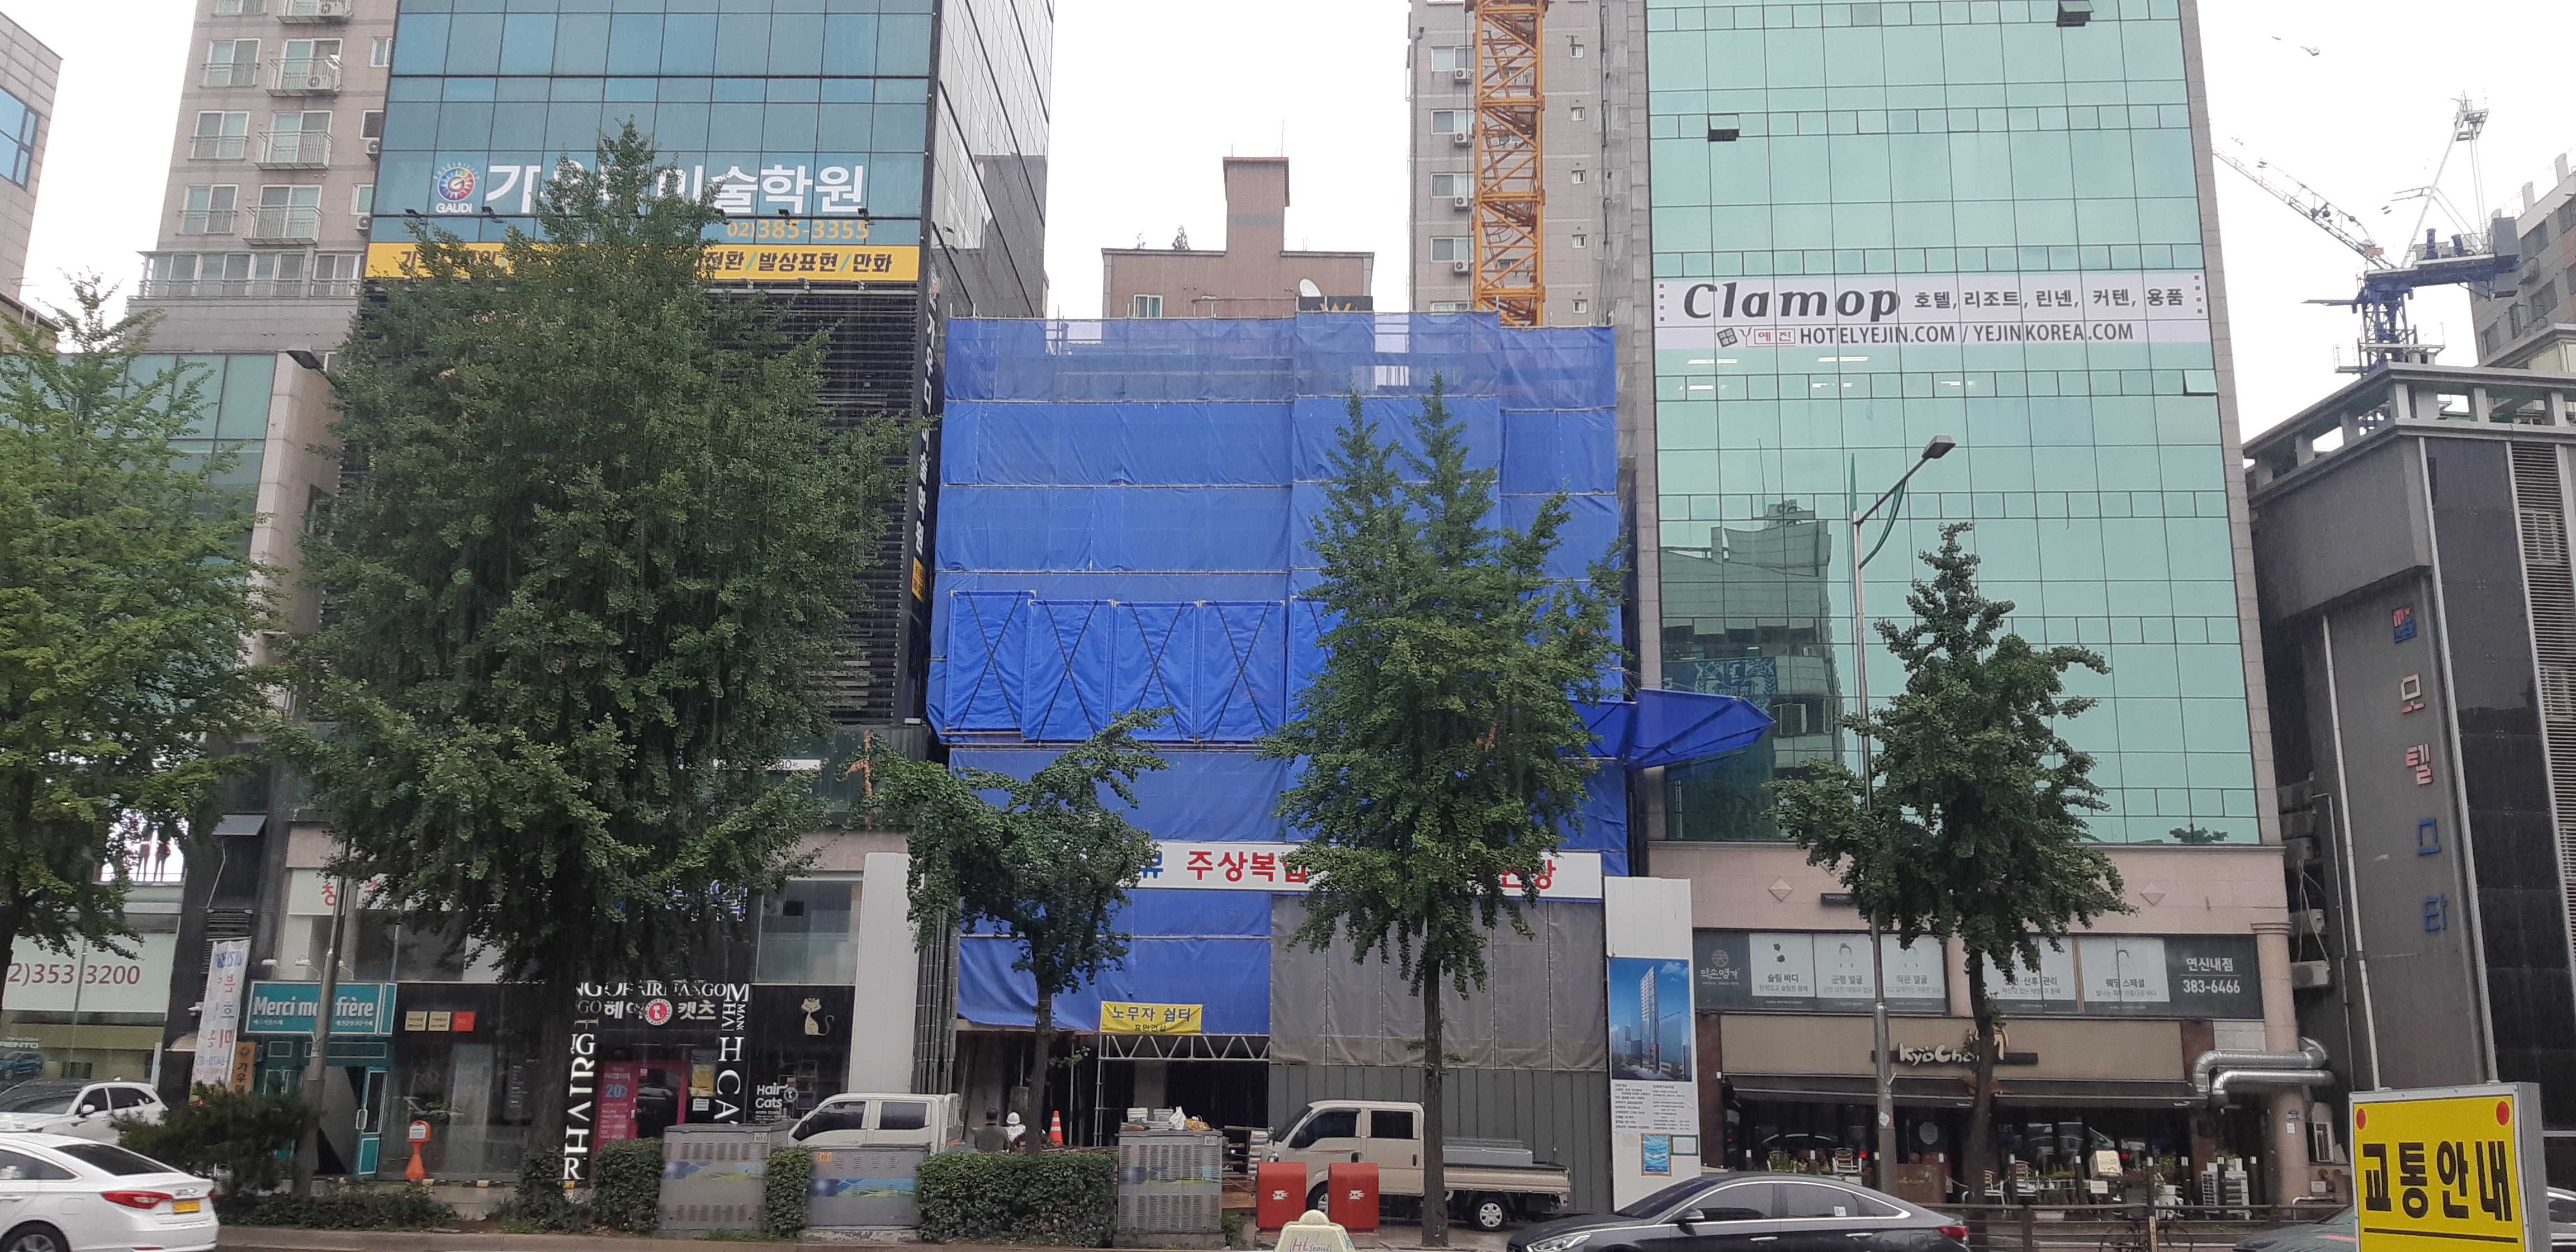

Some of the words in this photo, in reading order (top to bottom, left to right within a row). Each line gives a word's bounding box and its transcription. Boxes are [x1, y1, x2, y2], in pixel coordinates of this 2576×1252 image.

[435, 202, 473, 214] GAUDI
[727, 220, 868, 239] 02)385-3355
[1684, 281, 1900, 323] Clamop
[1914, 291, 1958, 309] 호텔,
[1964, 290, 2029, 309] 리조트,
[2093, 288, 2137, 307] 커텐,
[2147, 288, 2184, 306] 용품
[1801, 326, 1955, 344] HOTELYEJIN.COM
[2186, 957, 2234, 972] 연신내점
[84, 965, 141, 985] 3200
[1784, 973, 1799, 983] 바디
[2043, 976, 2058, 986] 관리
[2183, 980, 2240, 994] 383-6466
[253, 996, 296, 1016] Merci
[335, 996, 375, 1017] frère
[678, 999, 717, 1020] 캣츠
[1112, 1006, 1156, 1022] 노무자
[1163, 1008, 1191, 1022] 쉼터
[756, 1082, 789, 1095] Hair
[755, 1097, 783, 1108] Cats
[2362, 1140, 2513, 1222] 교통안내
